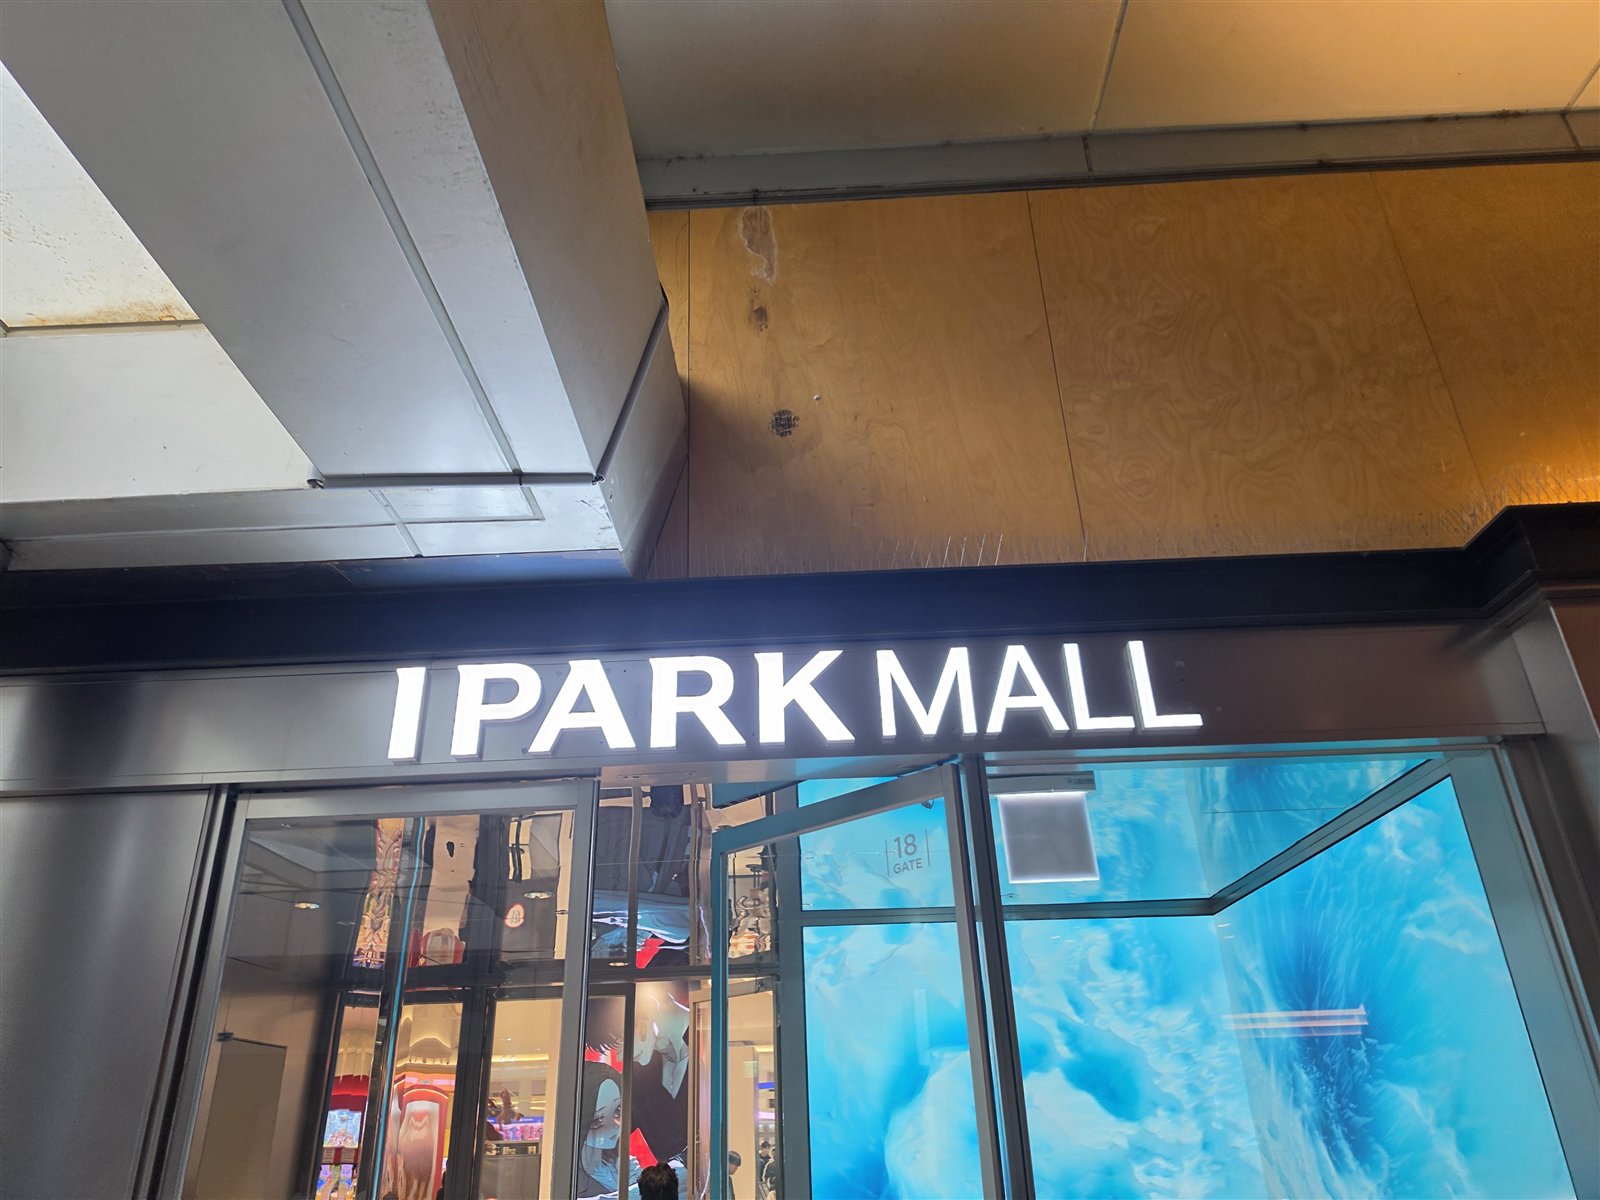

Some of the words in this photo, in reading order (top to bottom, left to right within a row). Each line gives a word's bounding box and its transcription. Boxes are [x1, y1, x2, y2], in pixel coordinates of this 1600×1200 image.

[876, 640, 1204, 742] MALL
[893, 833, 917, 858] 18
[893, 858, 923, 874] GATE
